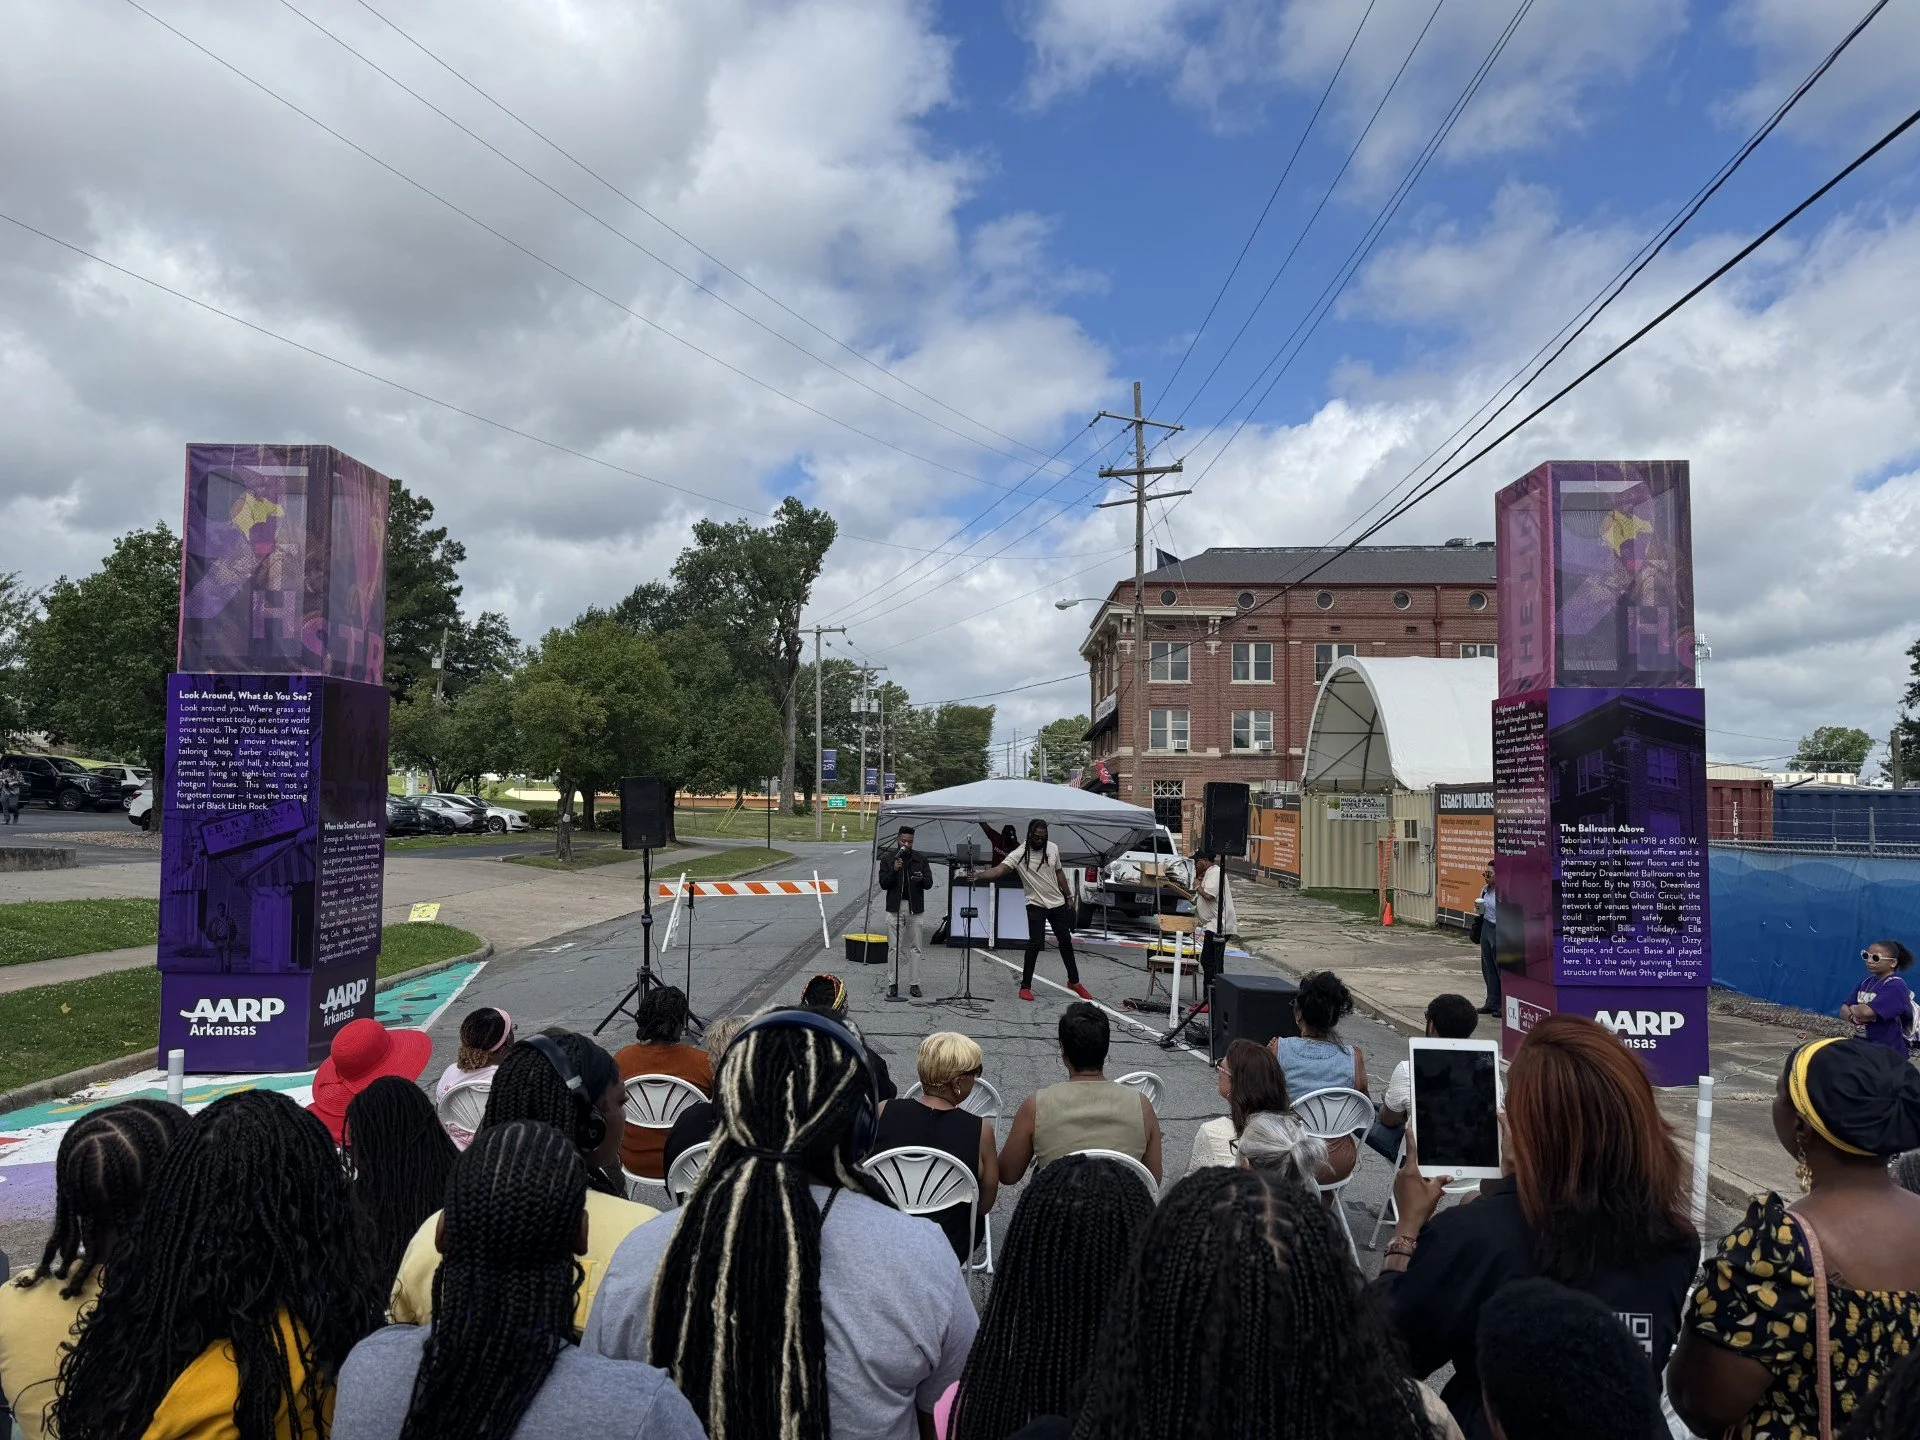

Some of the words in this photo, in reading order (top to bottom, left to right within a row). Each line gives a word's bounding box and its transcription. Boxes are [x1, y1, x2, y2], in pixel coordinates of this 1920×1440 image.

[179, 690, 200, 699] Look
[201, 690, 236, 701] Around,
[238, 691, 261, 700] What
[262, 692, 274, 700] do
[275, 692, 290, 700] You
[292, 692, 312, 701] See?
[180, 704, 198, 712] Look
[248, 704, 273, 713] Where
[276, 708, 294, 716] grass
[180, 716, 215, 724] pavement
[234, 716, 256, 725] today,
[224, 725, 238, 734] The
[259, 726, 278, 734] block
[291, 727, 310, 735] West
[178, 747, 208, 758] tailoring
[214, 748, 233, 758] shop,
[238, 748, 262, 756] barber
[268, 749, 298, 759] colleges,
[178, 768, 205, 777] families
[208, 769, 228, 780] living
[242, 770, 276, 780] tight-knit
[177, 780, 206, 790] shotgun
[245, 780, 260, 788] This
[177, 790, 211, 801] forgotten
[281, 792, 308, 802] beating
[1441, 794, 1462, 808] LEGACY
[1463, 792, 1494, 808] BUILDERS
[197, 802, 206, 810] of
[206, 802, 226, 810] Black
[248, 802, 269, 810] Rock.
[1560, 824, 1576, 832] The
[1578, 824, 1616, 833] Ballroom
[1618, 824, 1644, 833] Above
[1560, 836, 1591, 844] Taborian
[1593, 836, 1610, 845] Hall,
[1612, 836, 1628, 844] built
[1640, 836, 1657, 844] 1918
[1560, 847, 1576, 856] 9th,
[1607, 847, 1650, 857] professional
[1561, 858, 1597, 868] pharmacy
[1647, 858, 1668, 866] floors
[1561, 869, 1597, 880] legendary
[1599, 869, 1638, 877] Dreamland
[1641, 870, 1674, 878] Ballroom
[1561, 880, 1579, 888] third
[1582, 880, 1601, 888] floor.
[1604, 880, 1614, 890] By
[1632, 880, 1657, 889] 1930s,
[1660, 880, 1700, 889] Dreamland
[1562, 902, 1592, 910] network
[1594, 902, 1602, 910] of
[1656, 902, 1676, 910] Black
[1597, 912, 1626, 923] perform
[1642, 913, 1663, 924] safely
[1678, 914, 1702, 924] during
[1562, 924, 1606, 935] segregation.
[1618, 924, 1636, 932] Billie
[1647, 925, 1677, 935] Holiday,
[1563, 934, 1601, 946] Fitzgerald,
[1611, 935, 1627, 943] Cab
[1636, 935, 1672, 945] Calloway,
[1682, 935, 1702, 946] Dizzy
[1563, 946, 1596, 956] Gillespie,
[1616, 946, 1640, 954] Count
[1644, 946, 1663, 954] Basie
[1678, 946, 1702, 957] played
[1620, 957, 1636, 967] only
[1640, 958, 1672, 968] surviving
[1676, 958, 1702, 966] historic
[1658, 969, 1682, 979] golden
[1684, 971, 1698, 980] age.
[320, 978, 366, 1014] AARP
[180, 998, 285, 1022] AARP
[324, 1008, 354, 1027] Arkansas
[190, 1024, 256, 1036] Arkansas
